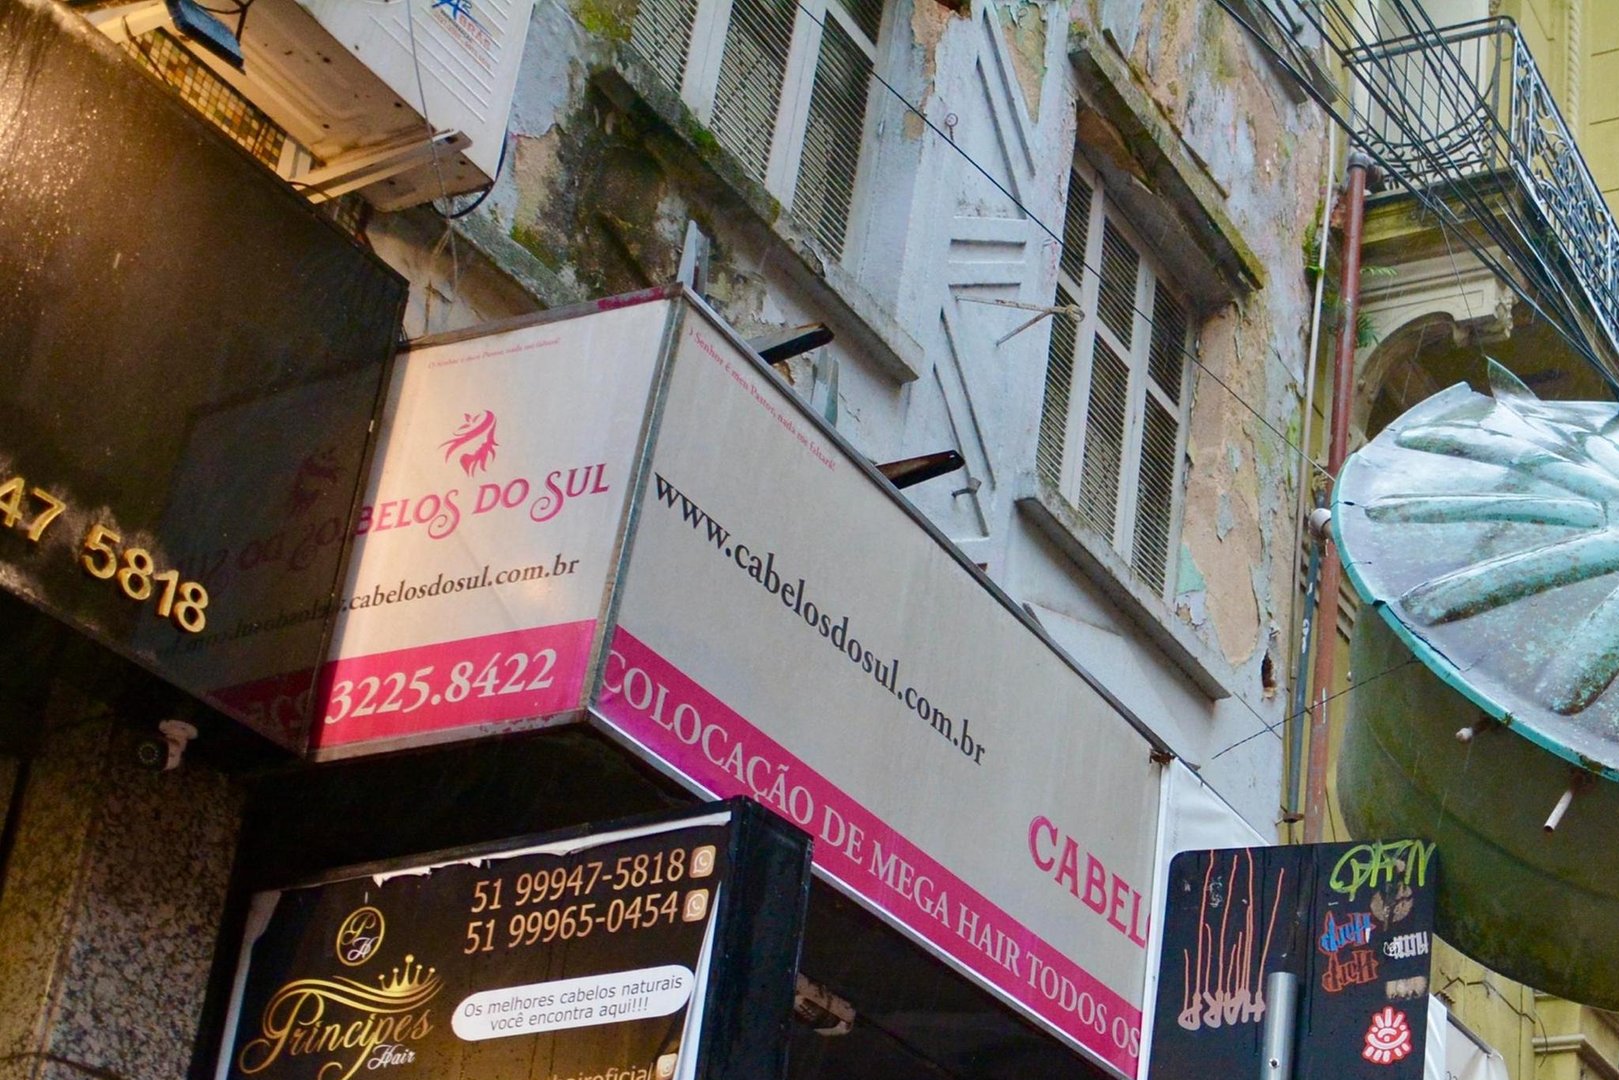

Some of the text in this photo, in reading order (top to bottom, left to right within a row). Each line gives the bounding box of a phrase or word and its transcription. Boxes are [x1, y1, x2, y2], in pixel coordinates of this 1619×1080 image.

[472, 478, 529, 514] DO
[530, 463, 610, 522] SUL
[0, 477, 66, 542] 47
[81, 523, 209, 633] 5818
[654, 472, 985, 765] www.cabelosdosul.com.br
[324, 649, 557, 724] 3225.8422
[471, 848, 686, 913] 51 99947-5818
[603, 650, 1140, 1058] COLOCAÇÃO DE MEGA HAIR TODOS OS
[1028, 815, 1150, 949] CABEL
[464, 891, 678, 954] 51 99965-0454
[464, 974, 683, 1018] Os melhores cabelos naturais
[490, 996, 649, 1031] você encontra aqui!!!
[367, 1044, 416, 1071] Hair
